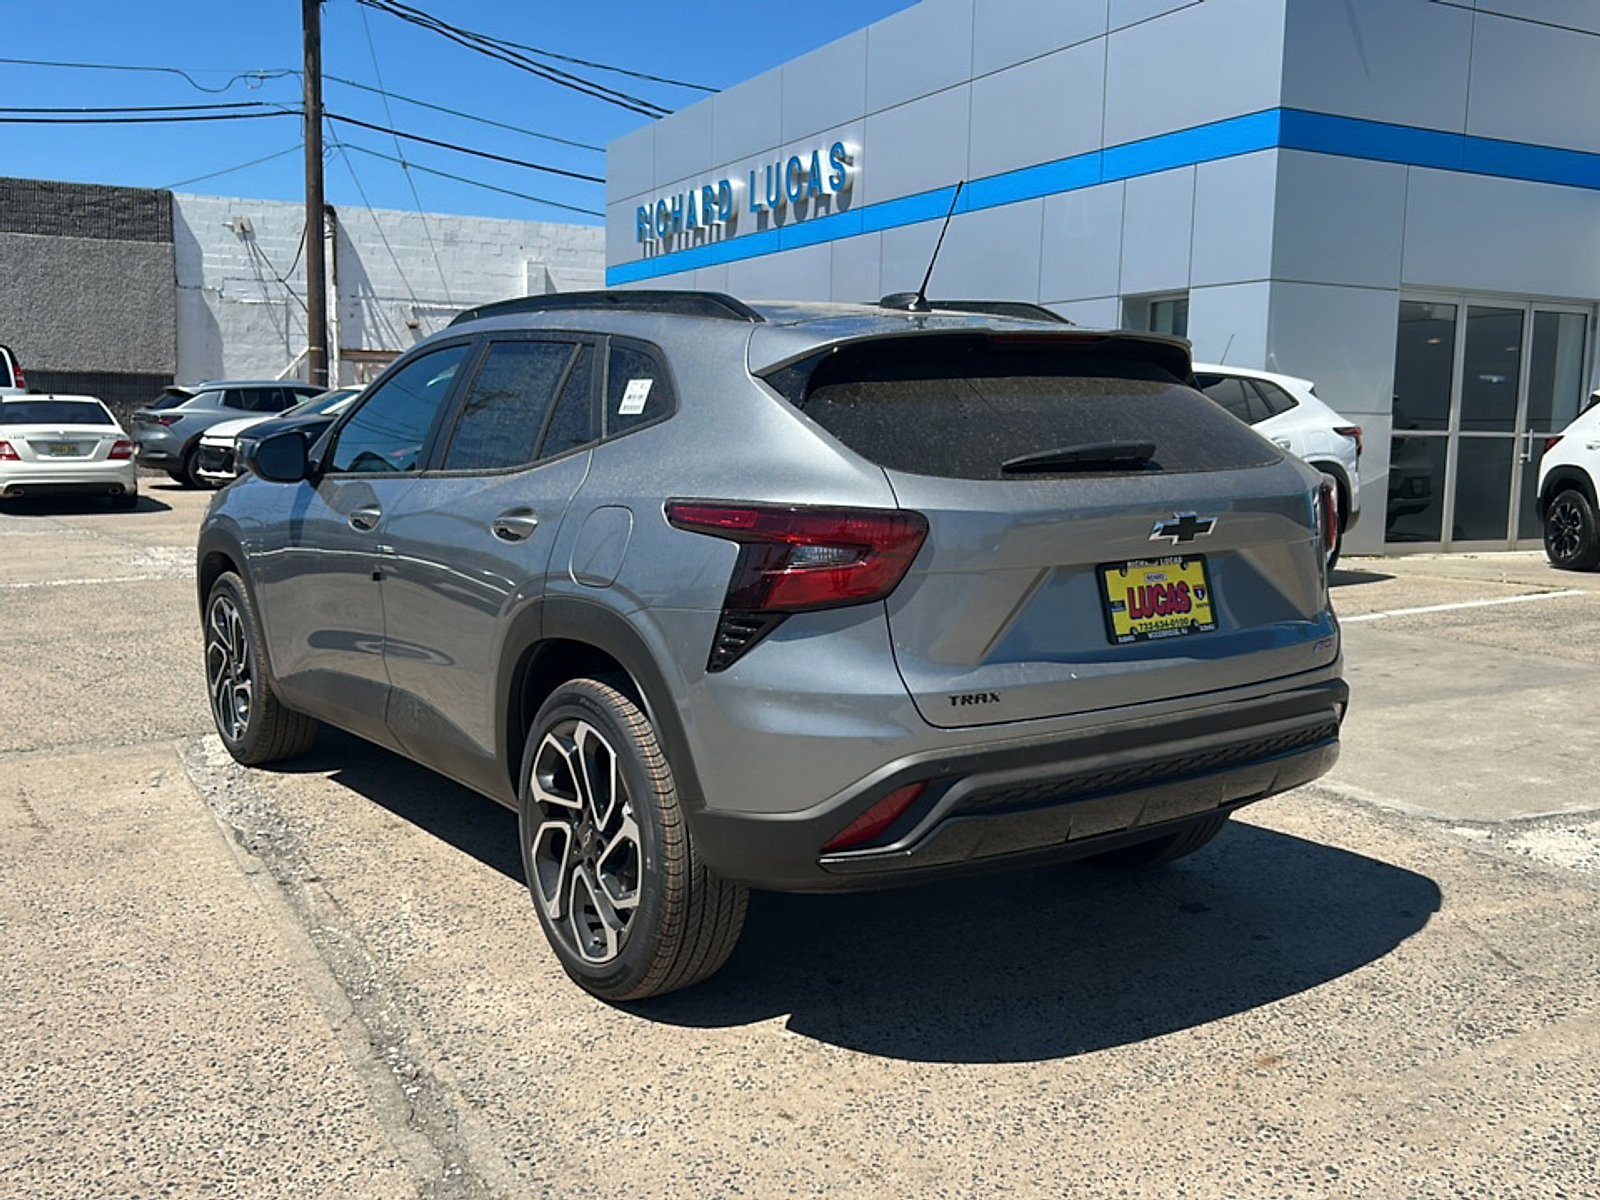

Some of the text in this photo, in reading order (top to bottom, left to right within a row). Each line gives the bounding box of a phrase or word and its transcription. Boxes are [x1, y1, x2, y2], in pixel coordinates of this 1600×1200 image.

[636, 141, 848, 242] RICHARD LUCAS
[1127, 580, 1192, 619] LUCAS
[947, 691, 1001, 706] TRAX
